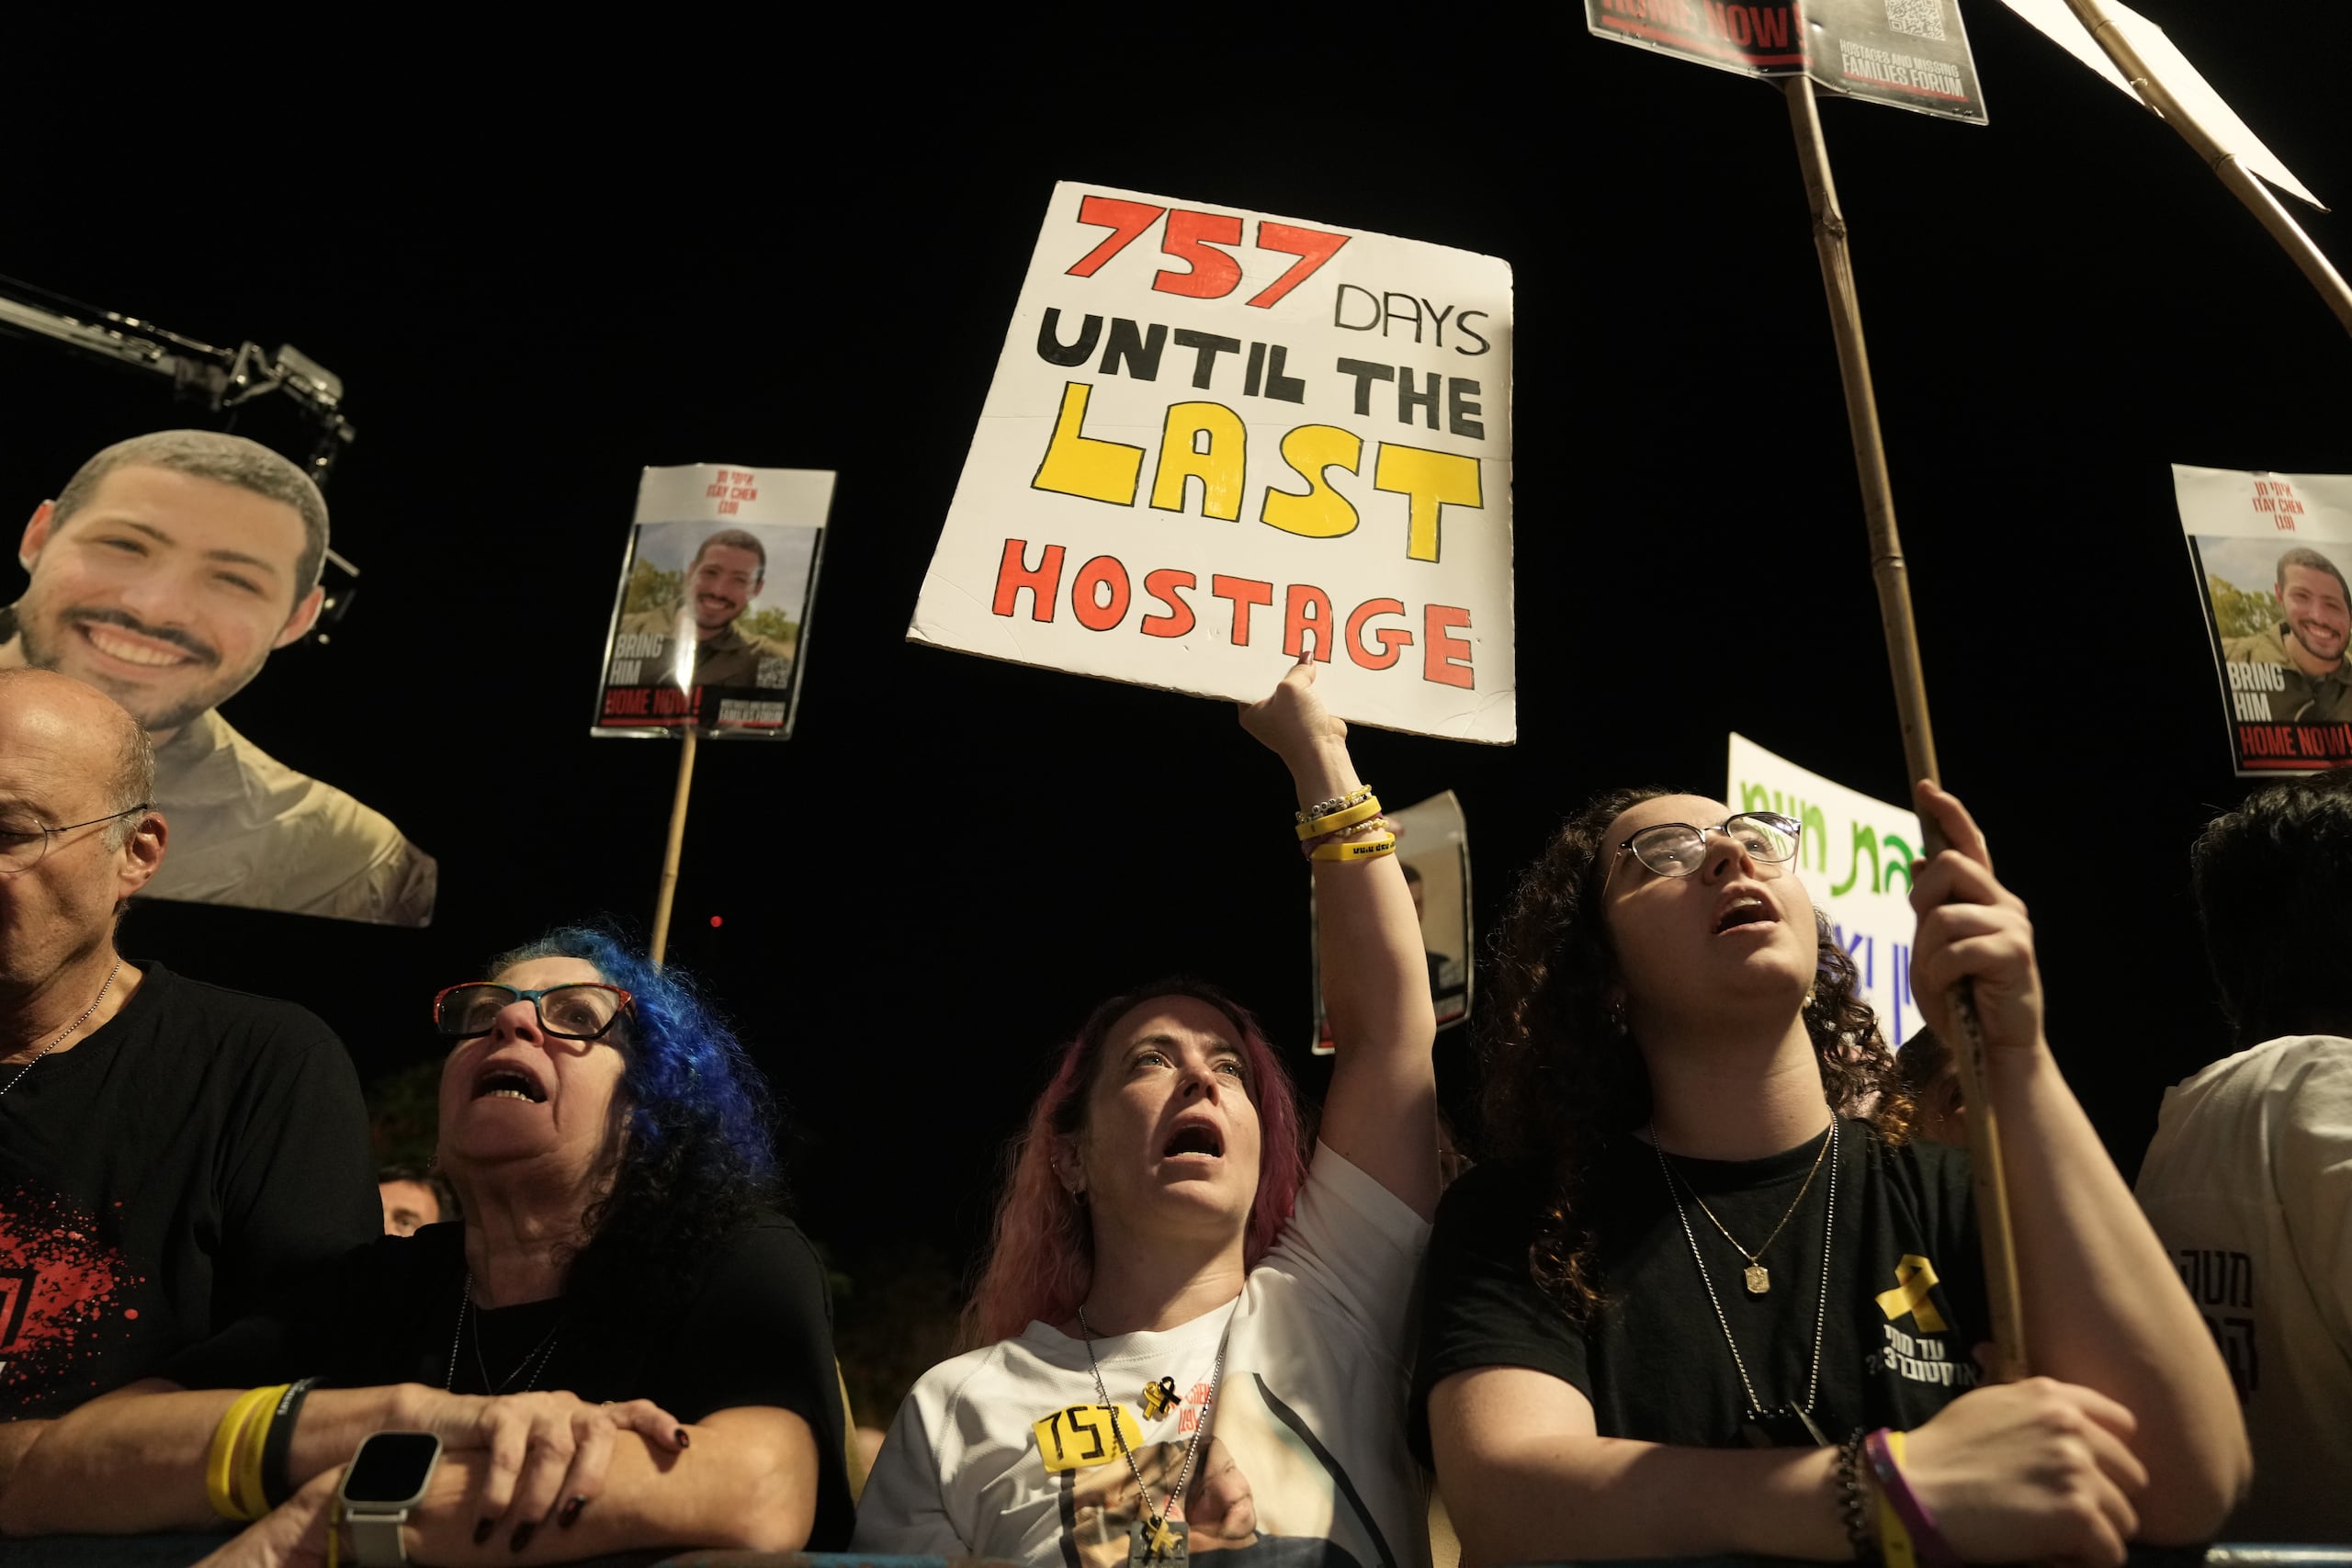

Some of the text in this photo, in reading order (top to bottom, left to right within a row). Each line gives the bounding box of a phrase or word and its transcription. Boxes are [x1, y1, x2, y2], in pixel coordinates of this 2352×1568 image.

[1839, 39, 1960, 78] HOSTAGES AND MISSING
[1842, 53, 1964, 97] FAMILIES FORUM
[1065, 195, 1490, 355] 757 DAYS
[1036, 307, 1485, 440] UNTIL THE
[1031, 381, 1484, 563] LAST
[2252, 497, 2304, 514] ITAY CHEN
[2274, 513, 2295, 532] (19)
[992, 538, 1475, 690] HOSTAGE
[616, 633, 663, 658] BRING
[609, 659, 642, 685] HIM
[2226, 661, 2285, 692] BRING
[605, 688, 650, 715] HOME
[2233, 693, 2272, 722] HIM
[2238, 726, 2297, 756] HOME
[1916, 1339, 1945, 1360] עד
[1036, 1405, 1126, 1462] 757
